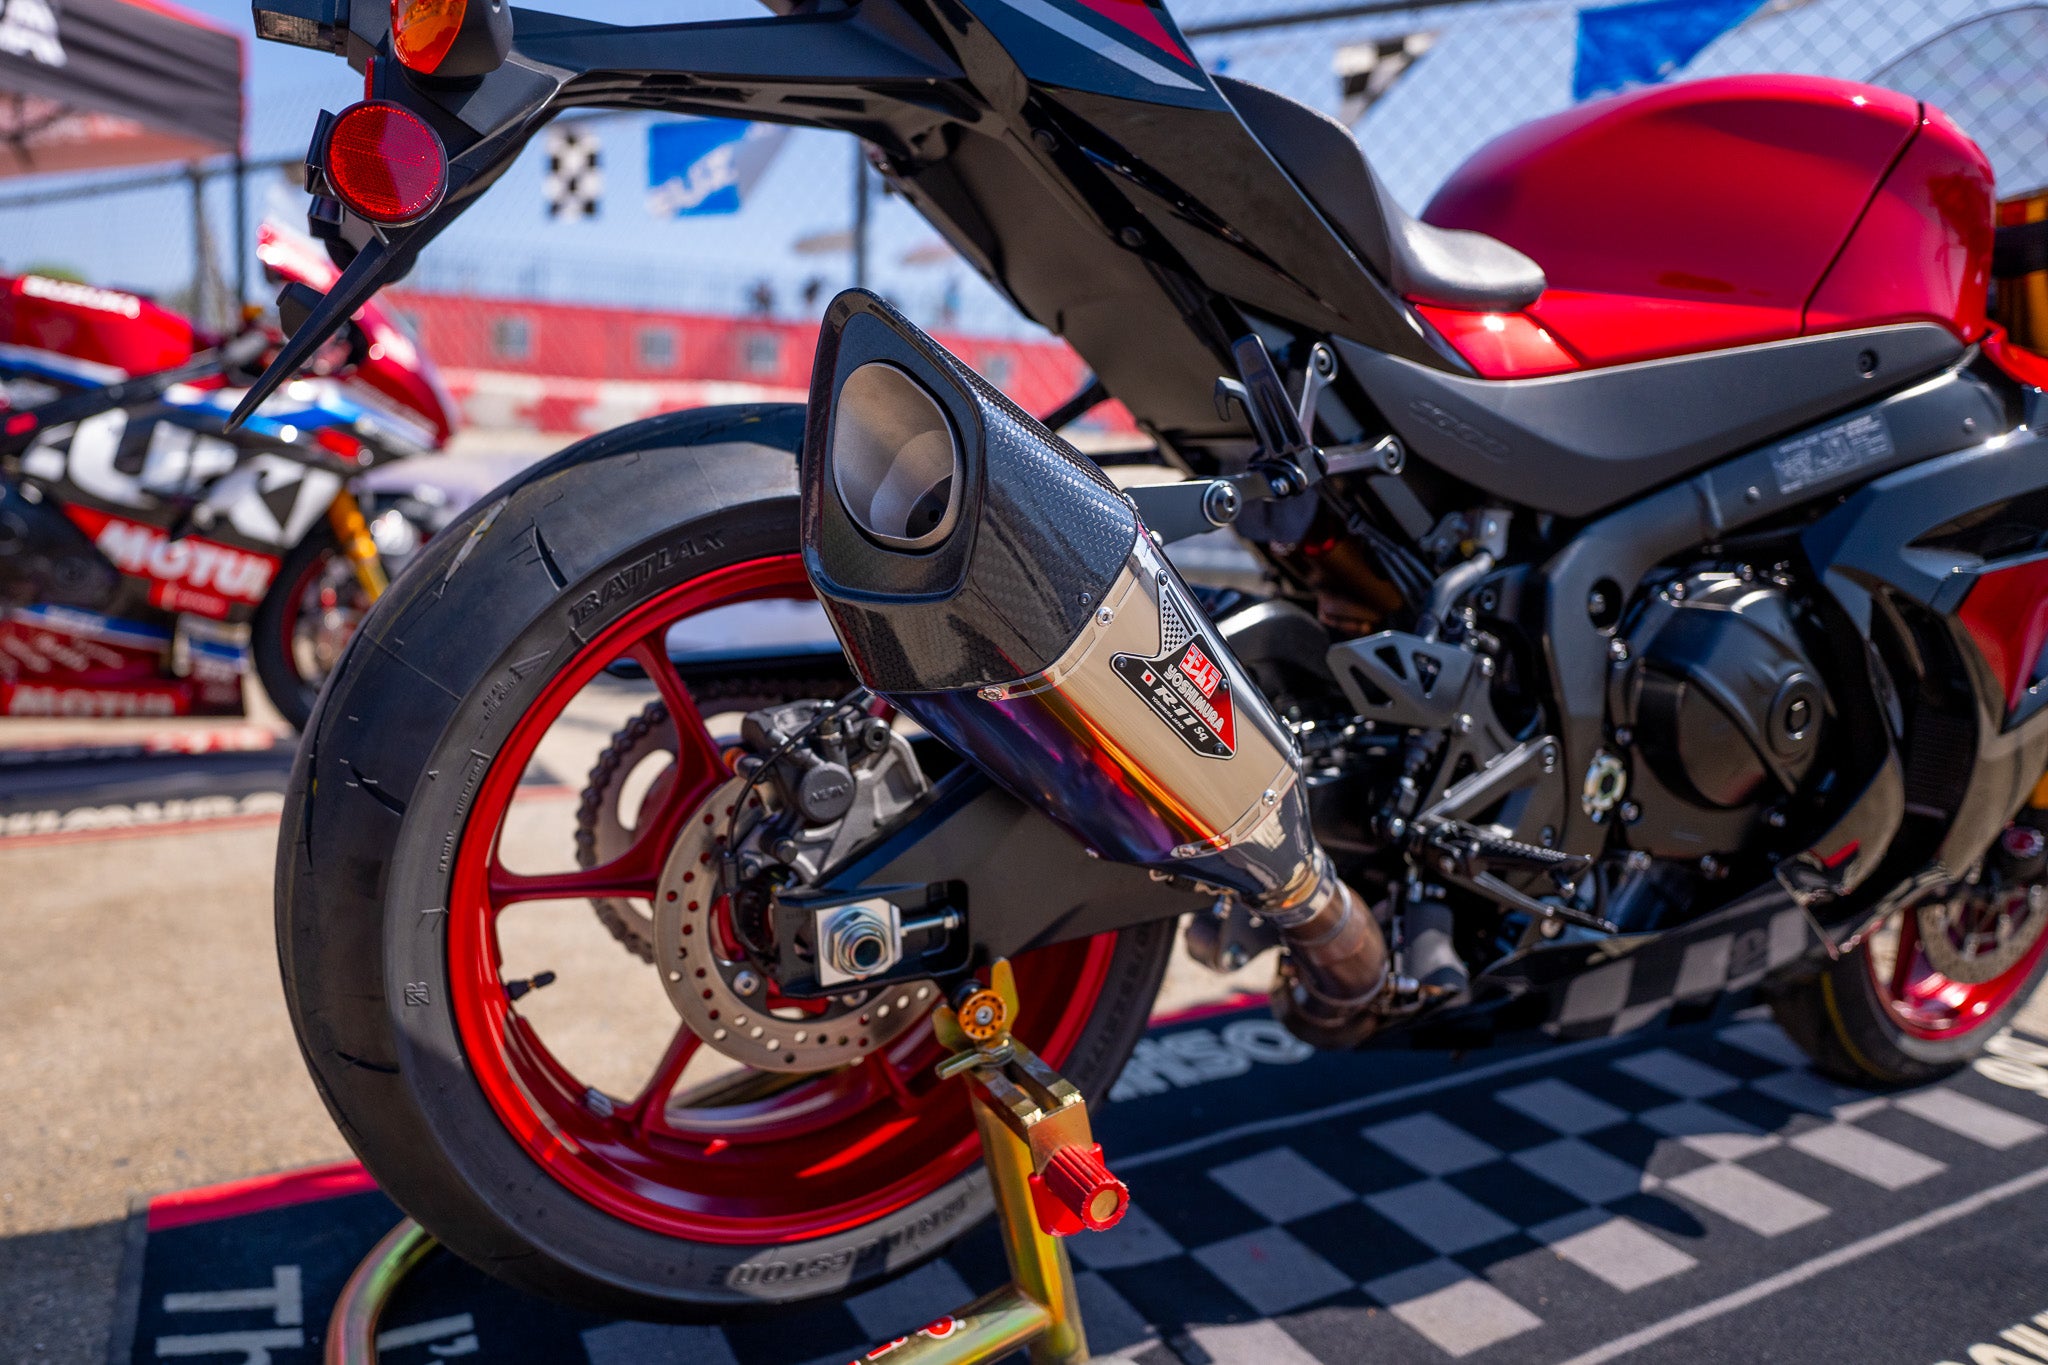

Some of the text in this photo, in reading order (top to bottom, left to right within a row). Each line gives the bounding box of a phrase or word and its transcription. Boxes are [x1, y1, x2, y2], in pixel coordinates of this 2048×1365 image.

[1154, 685, 1209, 743] R-11 Sq
[1163, 664, 1225, 733] YOSHIMURA
